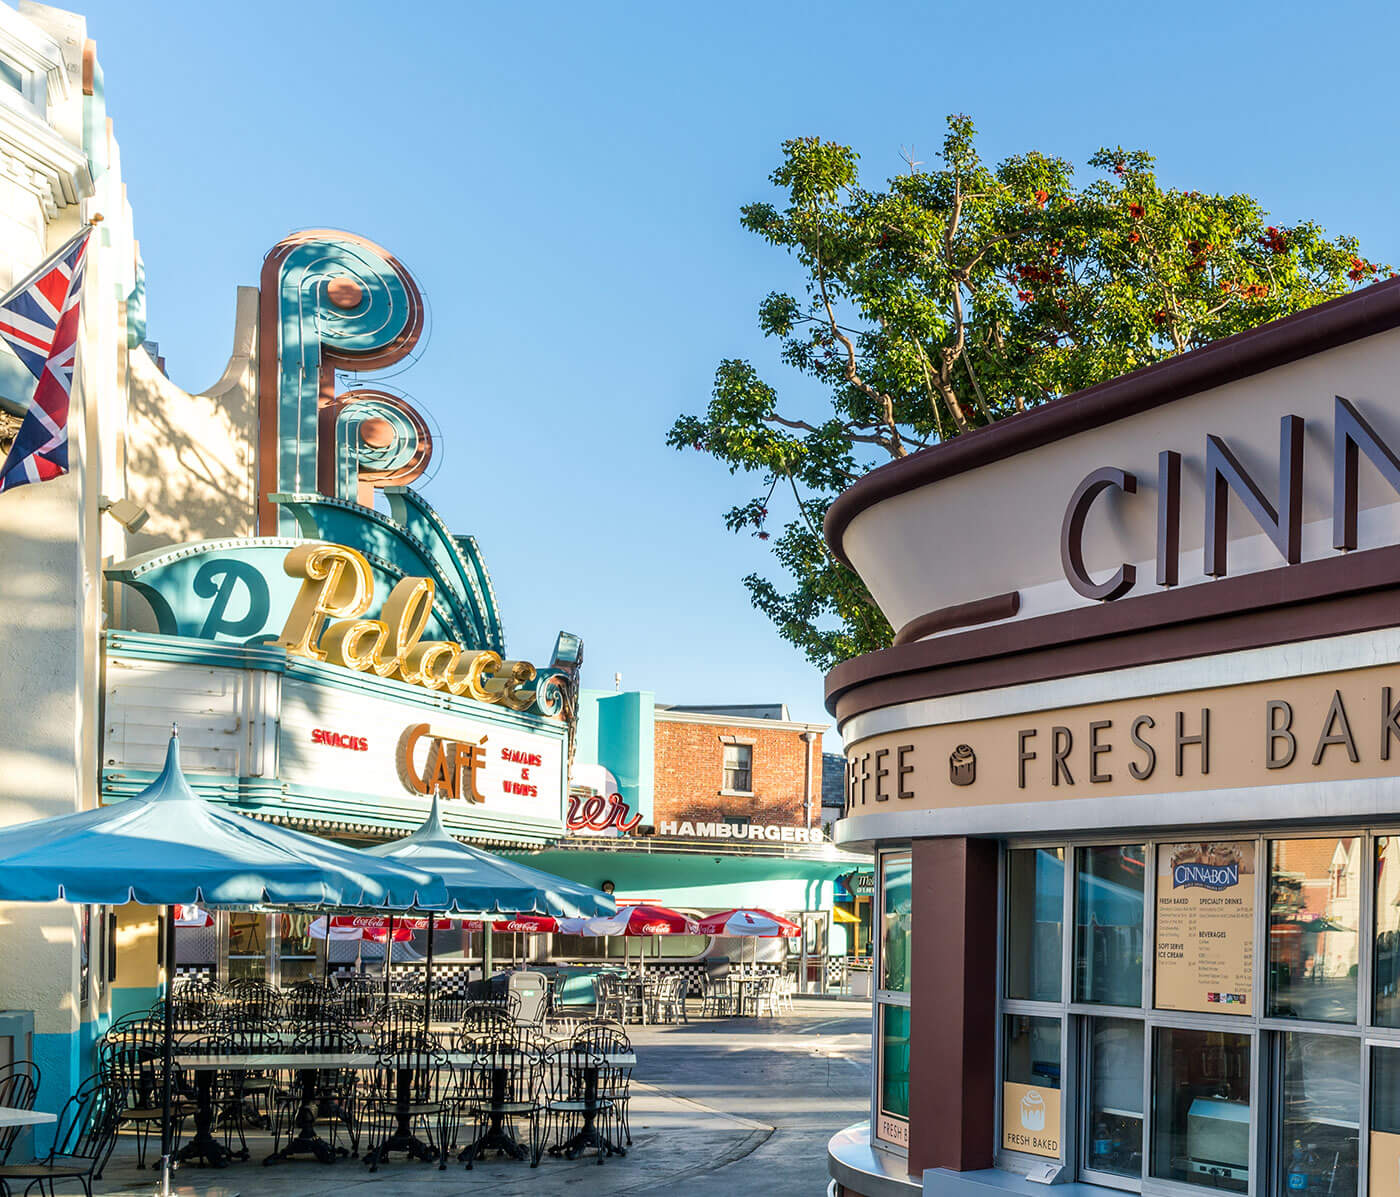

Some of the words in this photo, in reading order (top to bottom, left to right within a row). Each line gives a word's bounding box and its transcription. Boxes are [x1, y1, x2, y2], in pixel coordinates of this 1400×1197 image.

[265, 544, 536, 710] Palace
[311, 729, 368, 751] SNACKS
[1018, 714, 1210, 789] FRESH
[397, 723, 488, 803] CAFÉ
[660, 821, 824, 842] HAMBURGERS
[1175, 865, 1238, 884] CINNABON
[883, 1121, 902, 1138] FRESH
[1008, 1133, 1030, 1146] FRESH
[1033, 1137, 1057, 1151] BAKED
